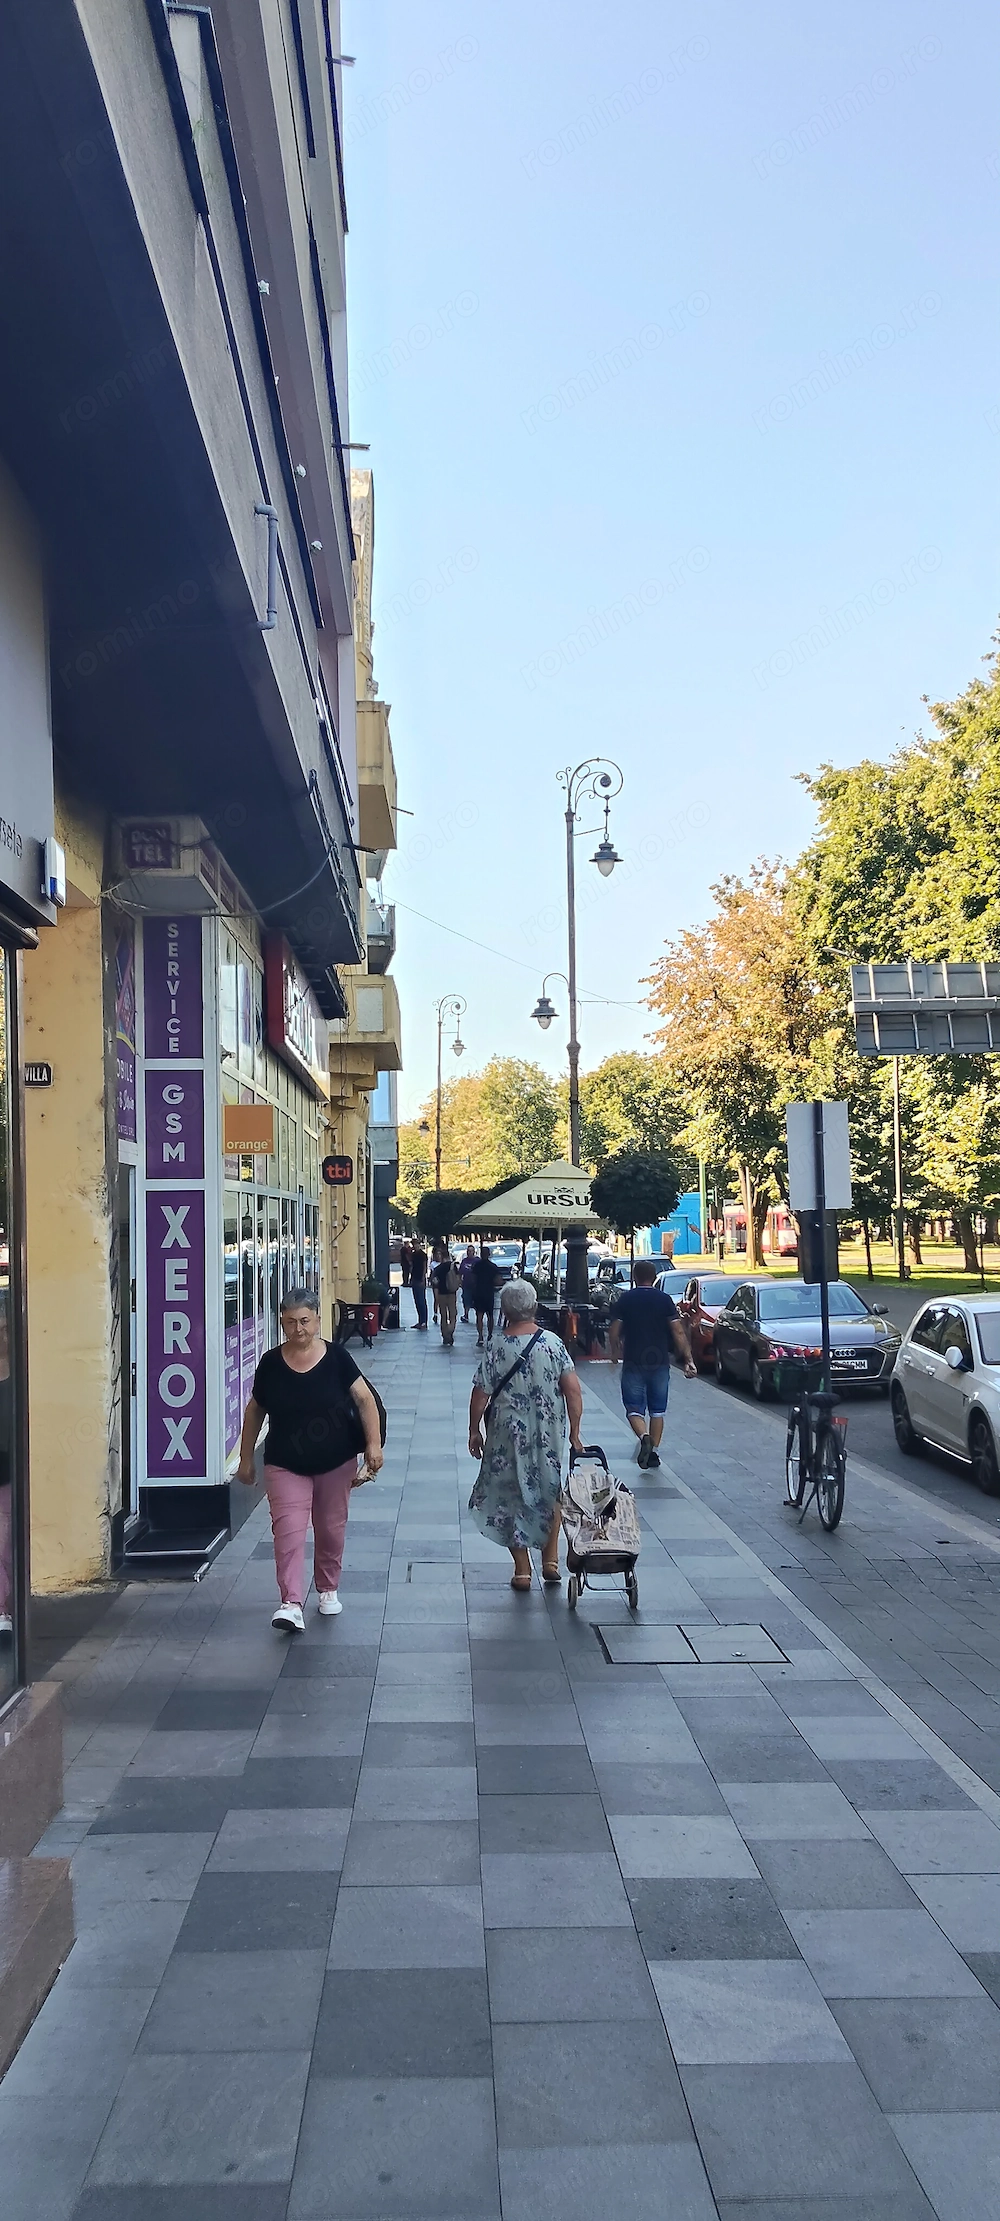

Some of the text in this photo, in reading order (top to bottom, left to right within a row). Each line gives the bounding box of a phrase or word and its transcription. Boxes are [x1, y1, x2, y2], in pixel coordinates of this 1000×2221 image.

[131, 844, 166, 862] TEL
[167, 923, 181, 1053] SERVICE
[162, 1083, 186, 1163] GSM
[226, 1139, 269, 1152] orange
[326, 1162, 351, 1179] tbi
[158, 1205, 196, 1461] XEROX
